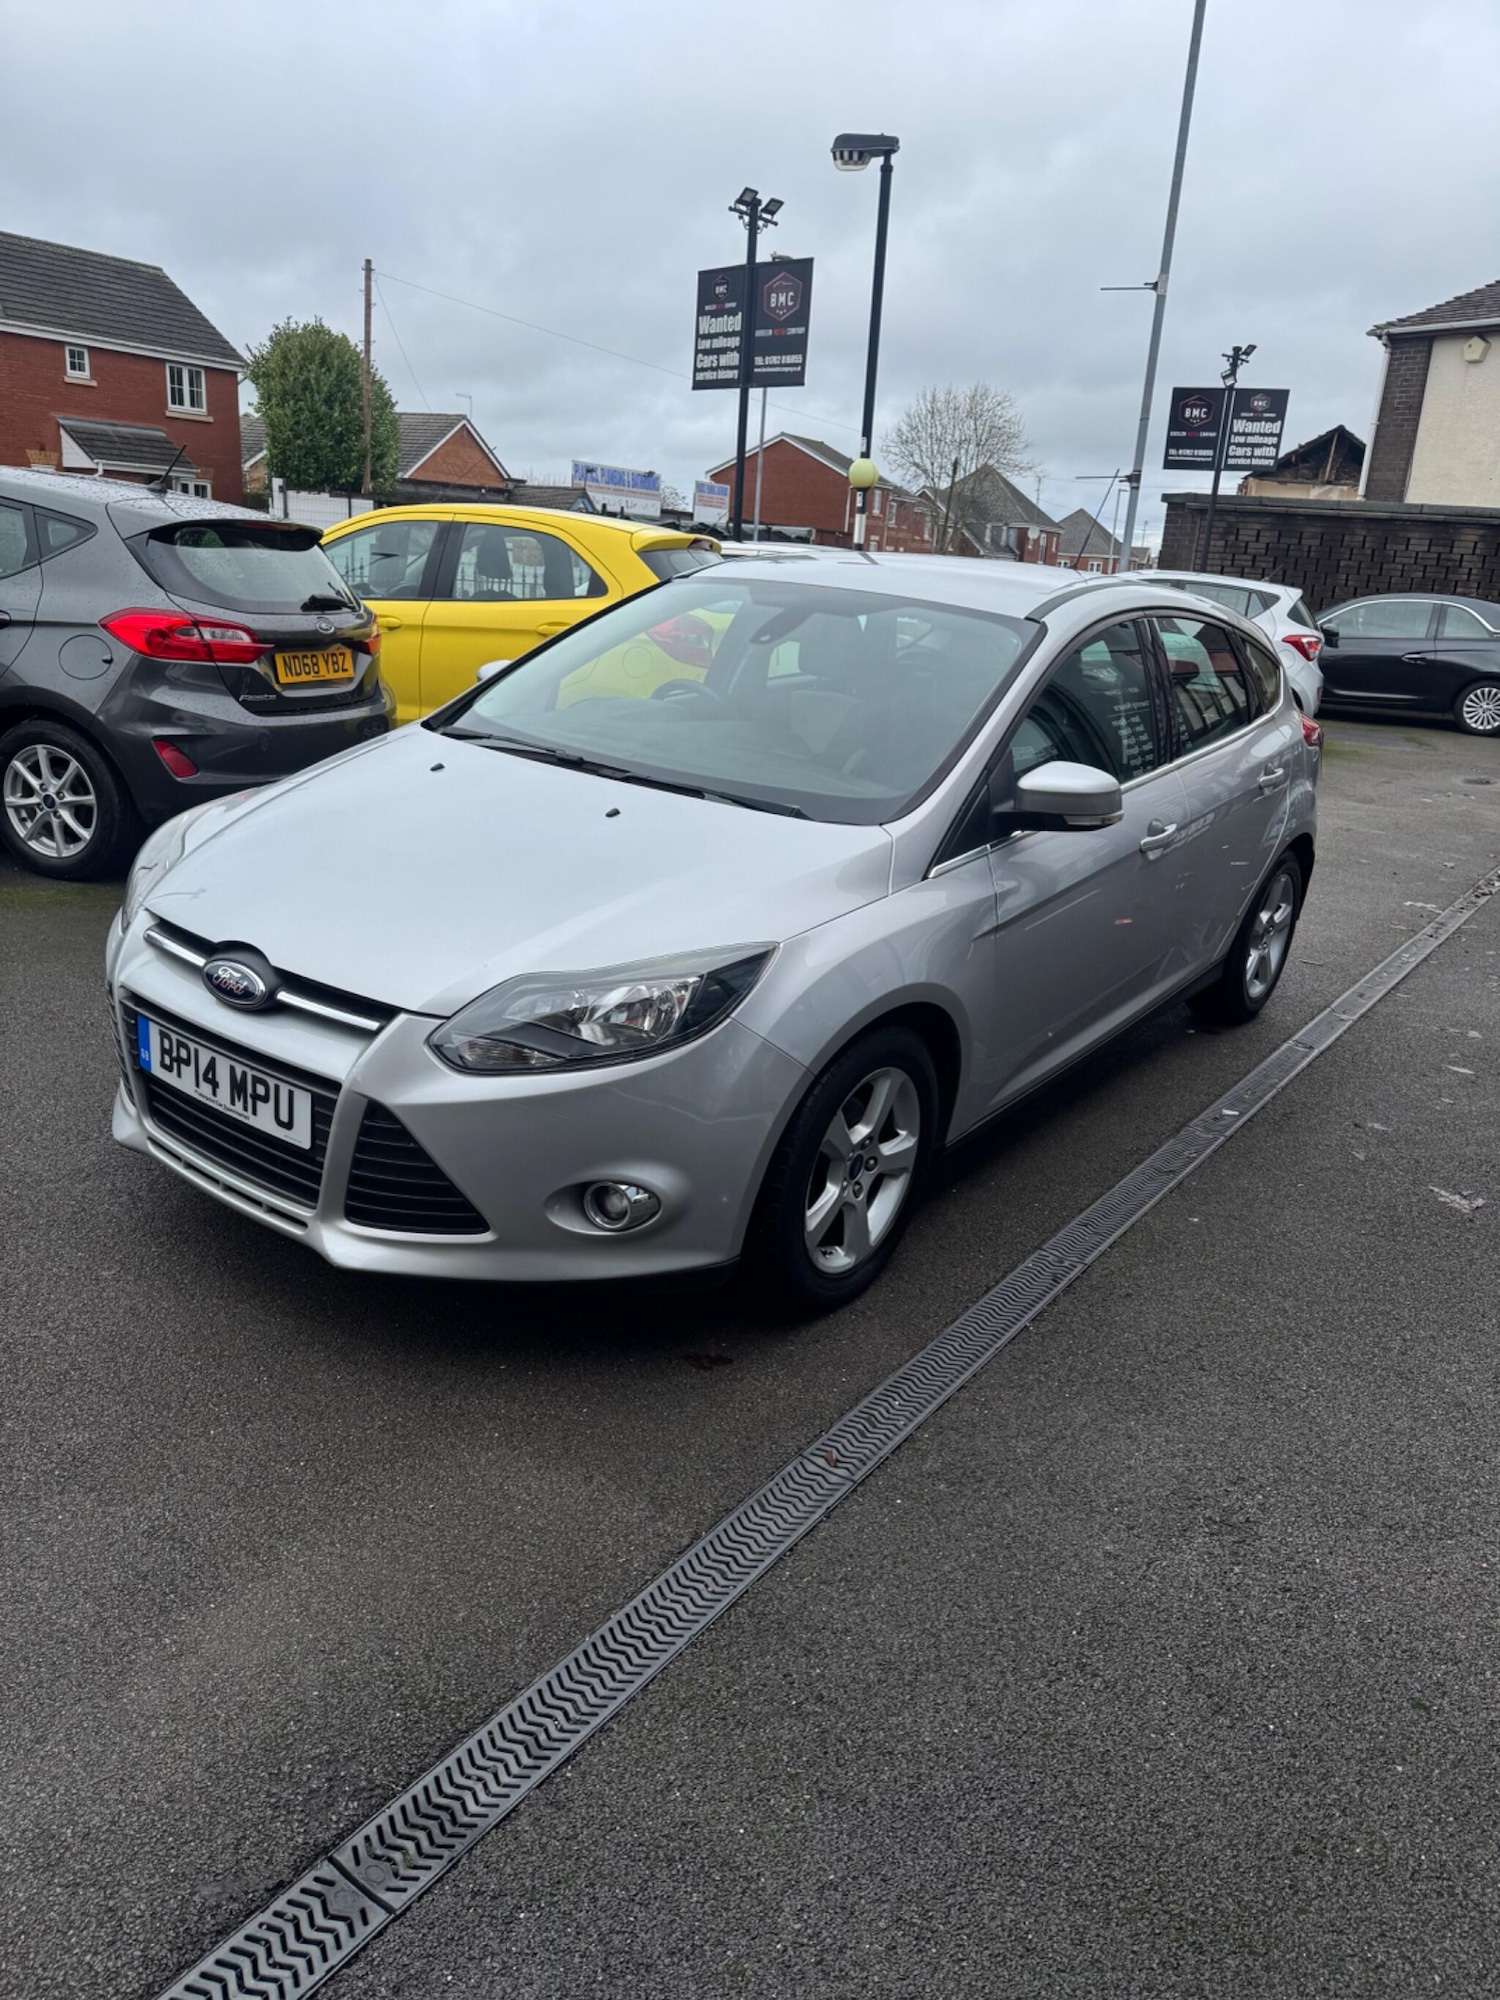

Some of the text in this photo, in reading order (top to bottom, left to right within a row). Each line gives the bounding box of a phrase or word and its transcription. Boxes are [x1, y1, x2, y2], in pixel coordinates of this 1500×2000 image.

[715, 285, 727, 294] BMC
[770, 292, 794, 307] BMC
[699, 312, 742, 334] Wanted
[697, 336, 740, 349] Low mileage
[696, 351, 740, 368] Cars with
[695, 369, 739, 380] service history
[1184, 407, 1208, 418] BMC
[1232, 419, 1281, 434] Wanted
[1230, 434, 1278, 445] Low mileage
[1228, 445, 1276, 457] Cars with
[1227, 457, 1275, 467] service history
[282, 651, 348, 677] ND68 YBZ
[212, 966, 248, 994] Ford
[158, 1027, 295, 1131] BP14 MPU
